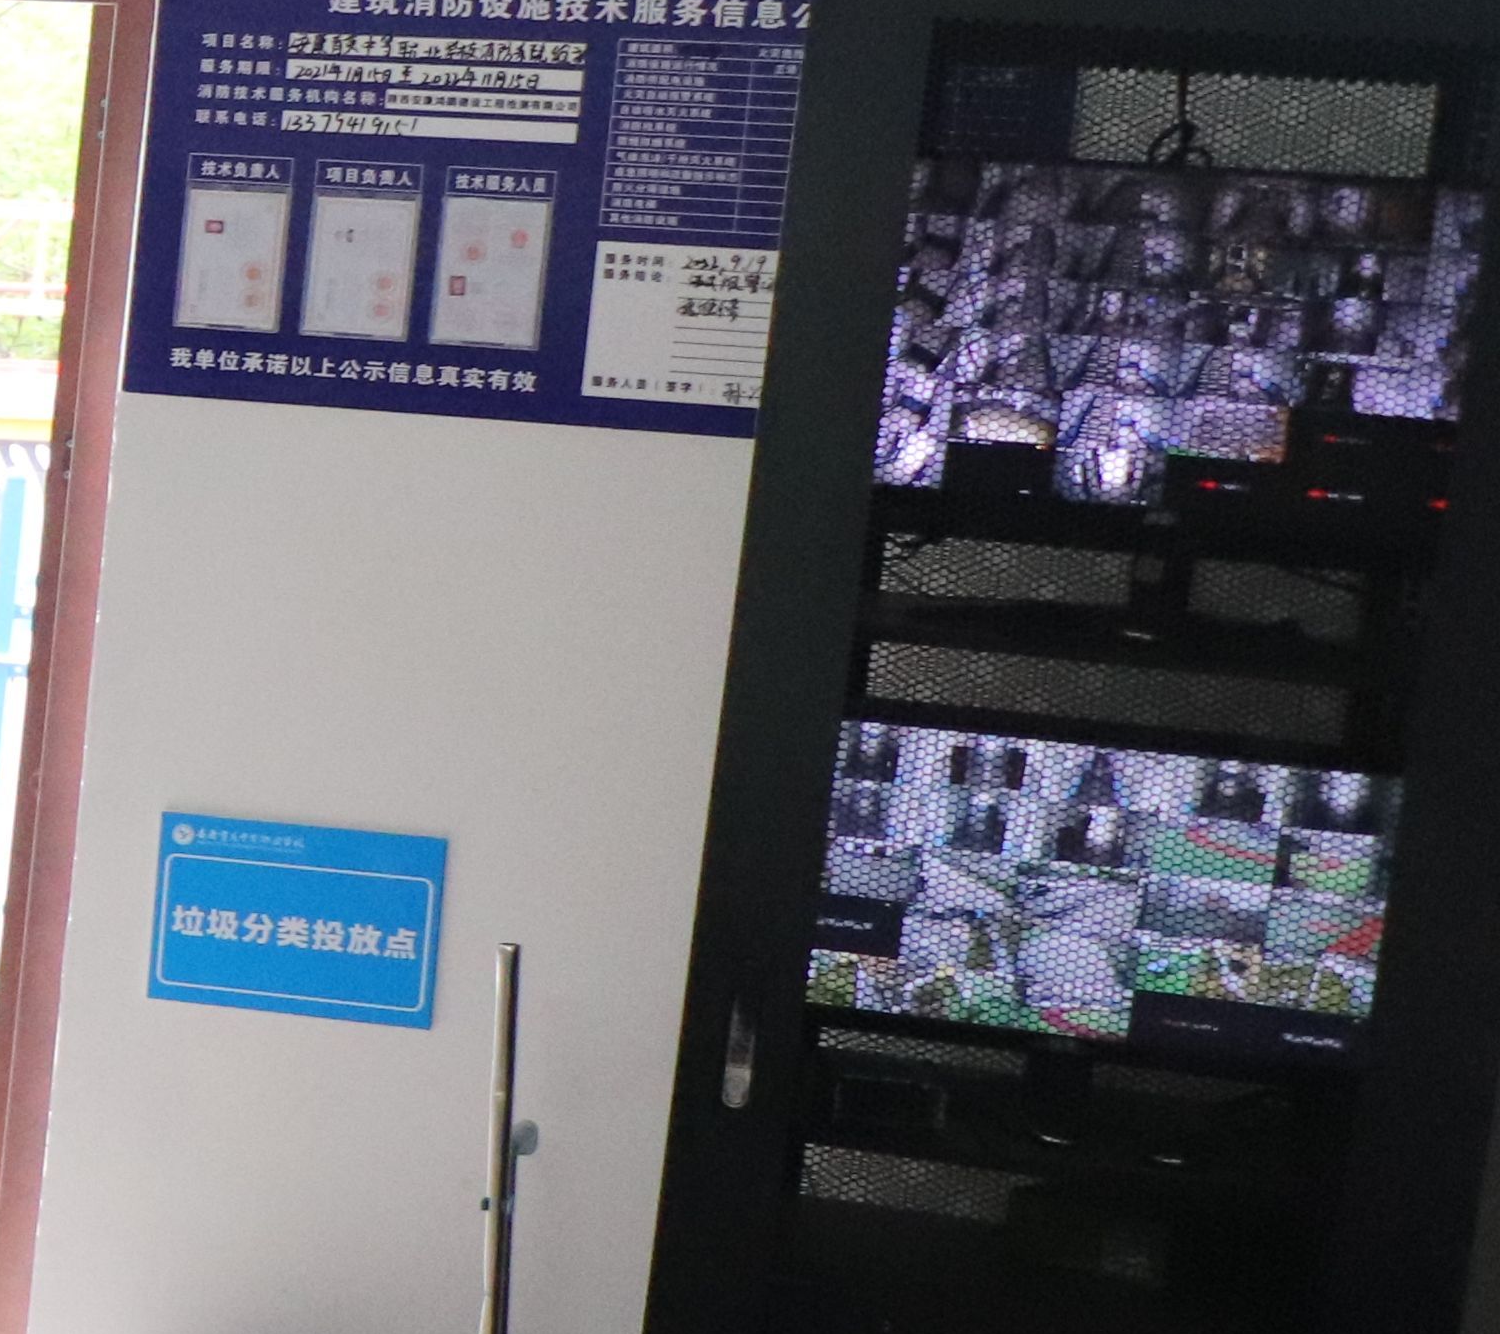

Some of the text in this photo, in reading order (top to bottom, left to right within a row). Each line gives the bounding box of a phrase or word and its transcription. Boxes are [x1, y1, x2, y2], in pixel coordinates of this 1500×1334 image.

[201, 32, 284, 51] 项目名称：
[199, 58, 280, 77] 服务期限：
[196, 83, 385, 107] 消防技术服务机构名称：
[194, 109, 277, 128] 联系电话：
[200, 160, 280, 181] 技术负责人
[324, 167, 414, 187] 项目负责人
[454, 173, 548, 194] 技术服务人员
[168, 346, 538, 394] 我单位承诺以上公示信息真实有效
[171, 904, 418, 960] 垃圾分类投放点
